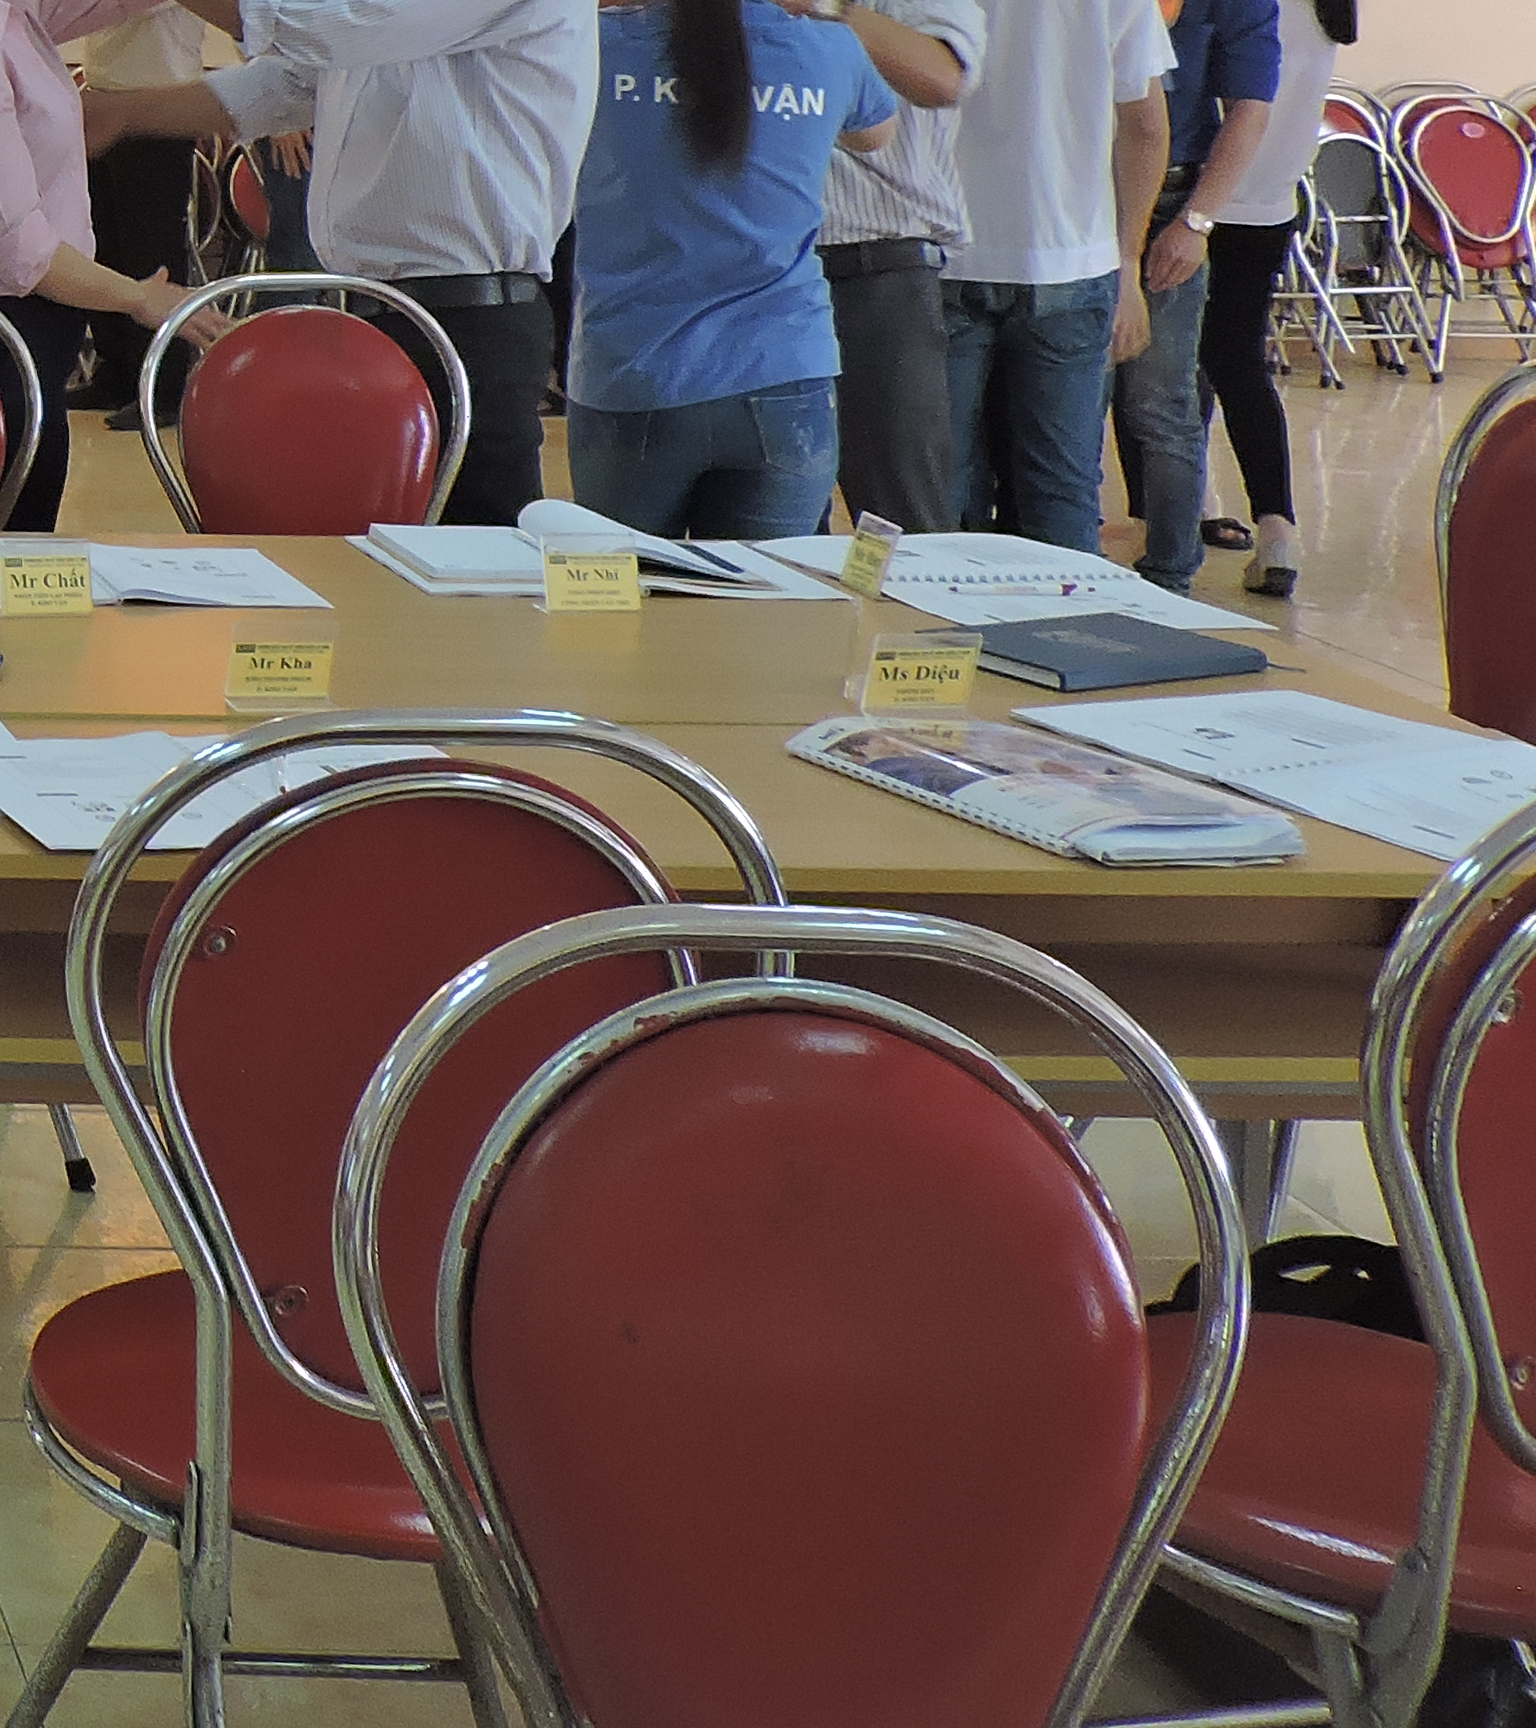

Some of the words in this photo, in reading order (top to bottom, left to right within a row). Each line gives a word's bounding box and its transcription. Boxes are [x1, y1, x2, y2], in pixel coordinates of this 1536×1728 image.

[614, 74, 640, 102] P.
[752, 83, 825, 120] VẬN
[9, 573, 37, 589] Mr
[43, 567, 86, 589] Chất
[567, 568, 588, 581] Mr
[250, 656, 274, 669] Mr
[879, 666, 908, 681] Ms
